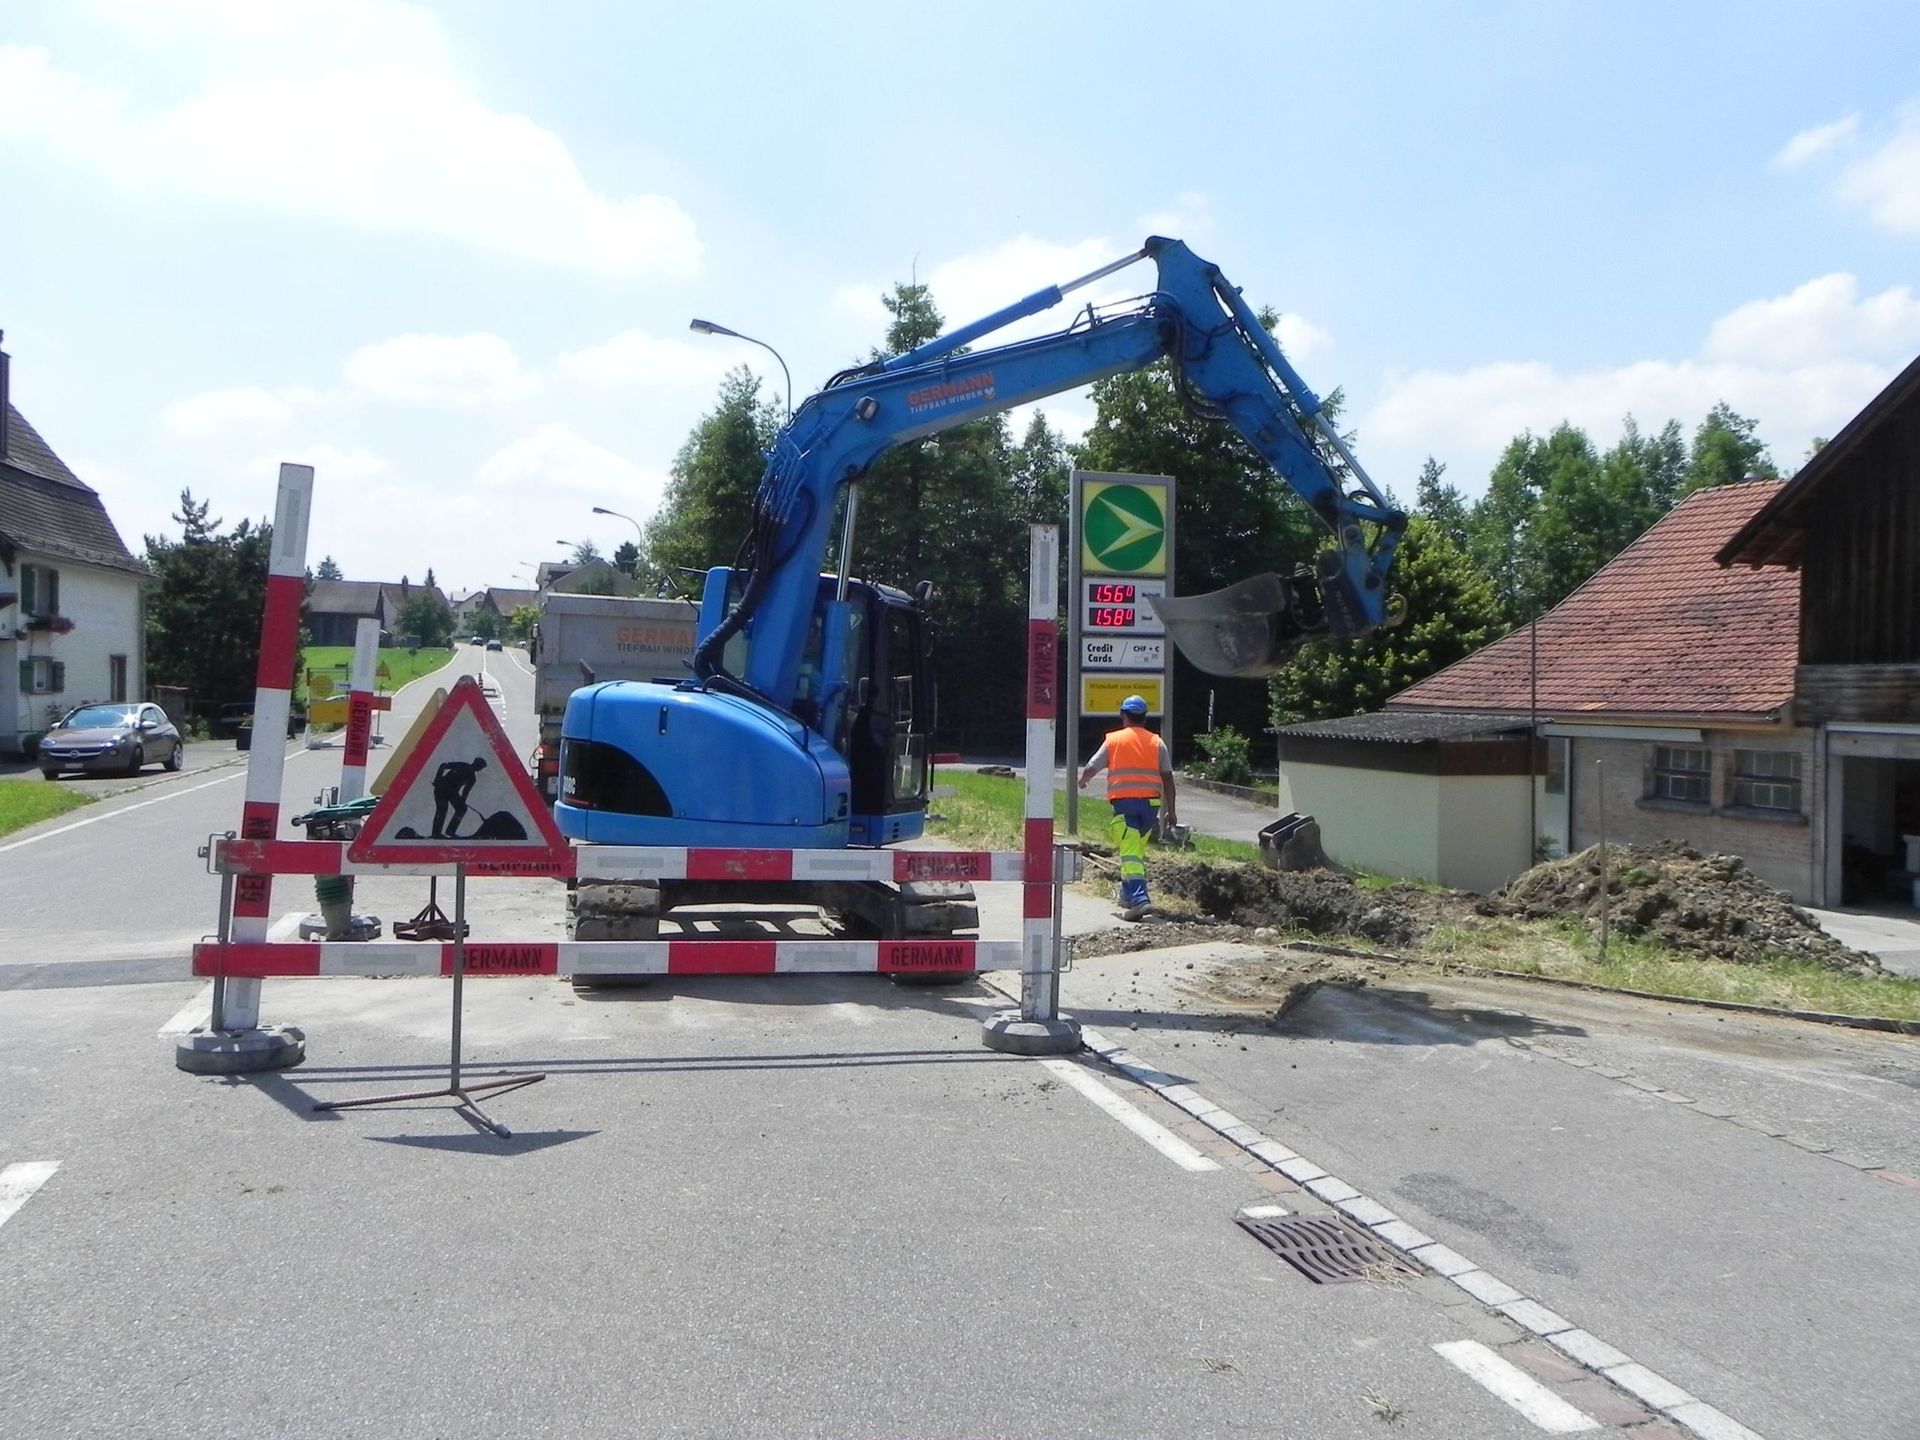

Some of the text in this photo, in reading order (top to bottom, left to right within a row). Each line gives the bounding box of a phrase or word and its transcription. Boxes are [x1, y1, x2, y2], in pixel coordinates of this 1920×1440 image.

[906, 371, 993, 407] GERMANN
[910, 390, 983, 414] TIEFBAU WINDEN
[617, 643, 660, 653] TIEFBAU
[1087, 643, 1113, 653] Credit
[1133, 645, 1146, 653] CHF
[1088, 653, 1113, 663] Cards
[890, 946, 964, 967] GERMANN
